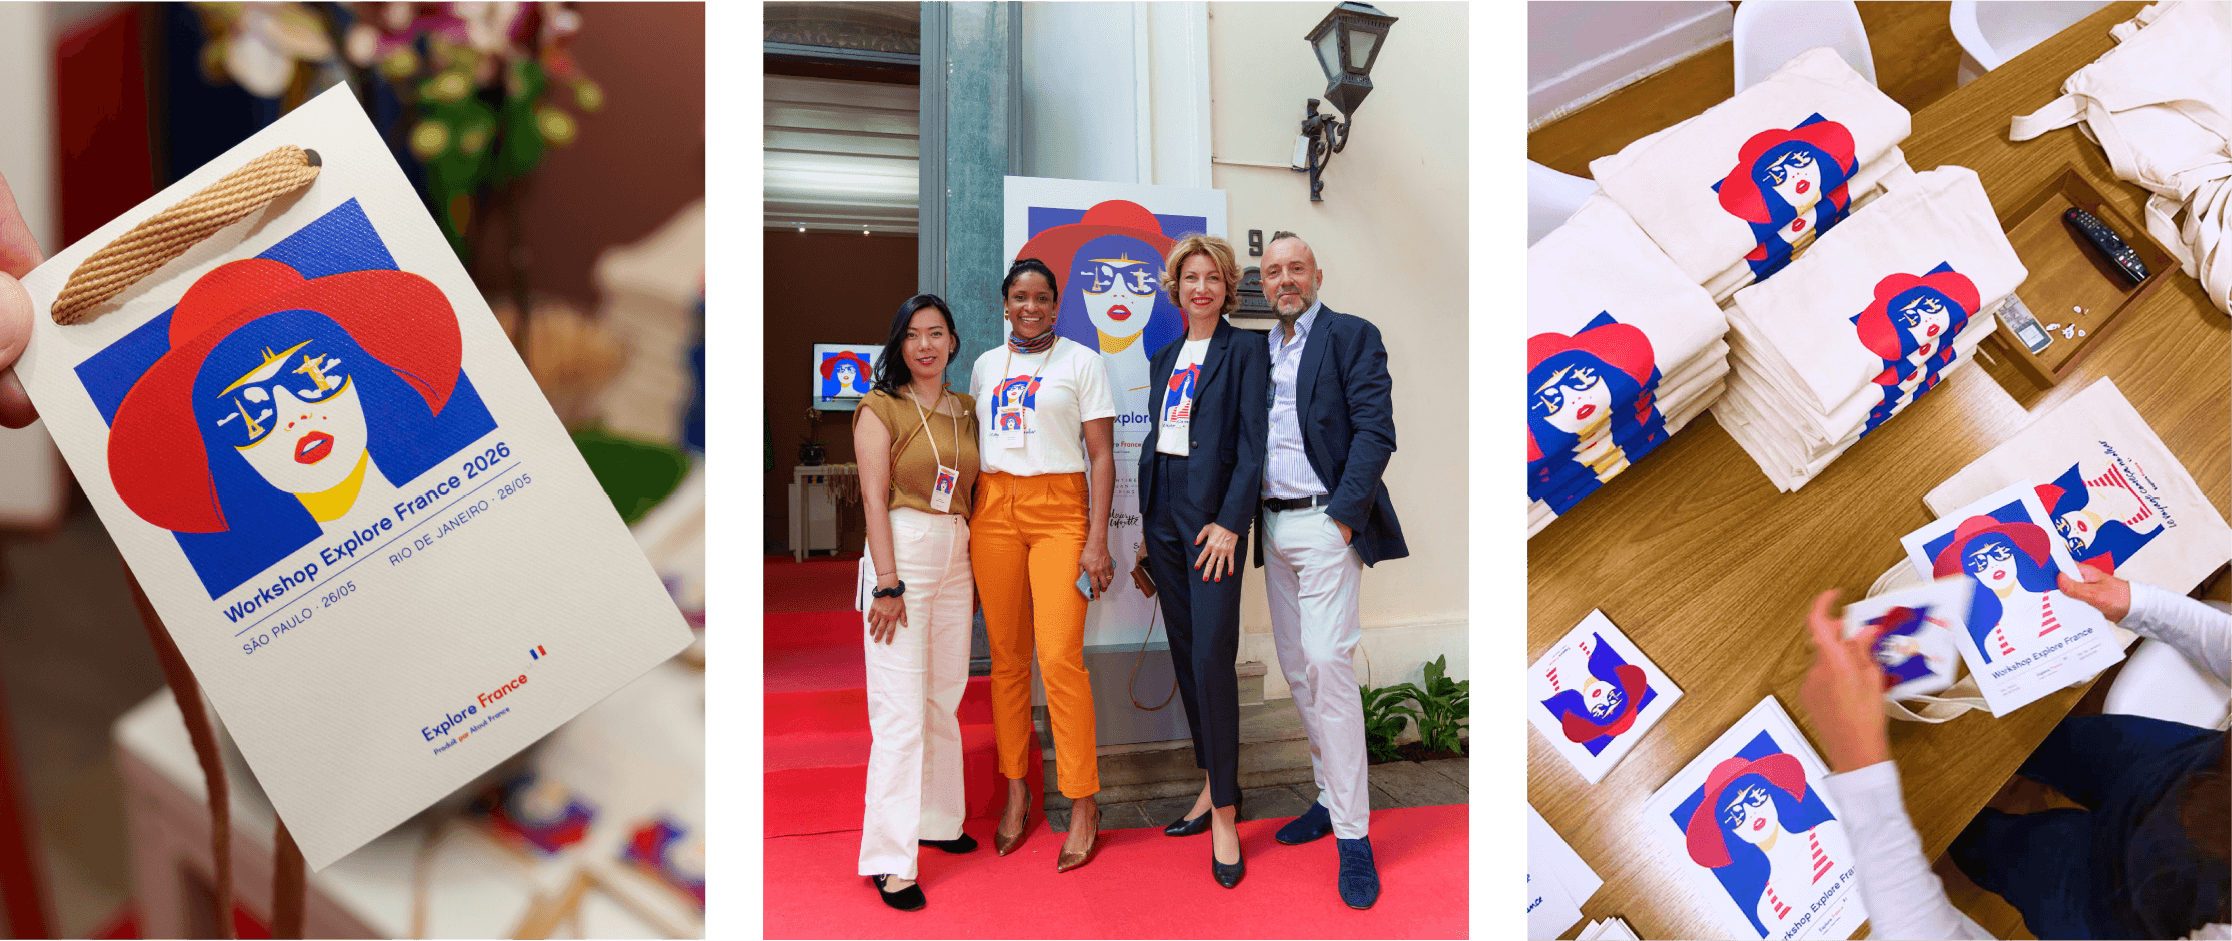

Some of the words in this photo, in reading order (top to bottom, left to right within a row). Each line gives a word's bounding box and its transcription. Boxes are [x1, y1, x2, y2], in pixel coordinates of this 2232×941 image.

[1113, 411, 1152, 427] xplor
[1120, 440, 1142, 448] France
[223, 562, 319, 624] Workshop
[319, 517, 394, 568] Explore
[393, 475, 462, 522] France
[462, 441, 511, 480] 2026
[388, 547, 413, 567] RIO
[413, 533, 434, 552] DE
[435, 499, 490, 540] JANEIRO
[496, 473, 533, 501] 28/05
[242, 634, 270, 656] SÃO
[271, 608, 313, 639] PAULO
[320, 580, 357, 608] 26/05
[1991, 656, 2033, 680] Workshop
[2032, 640, 2064, 662] Explore
[2063, 627, 2094, 645] France
[421, 705, 478, 742] Explore
[477, 674, 528, 708] France
[433, 738, 458, 756] Produit
[458, 732, 469, 743] par
[469, 719, 489, 734] About
[487, 706, 511, 723] France
[1780, 912, 1812, 941] rkshop
[1810, 881, 1841, 914] Explore
[1839, 865, 1856, 884] Fra
